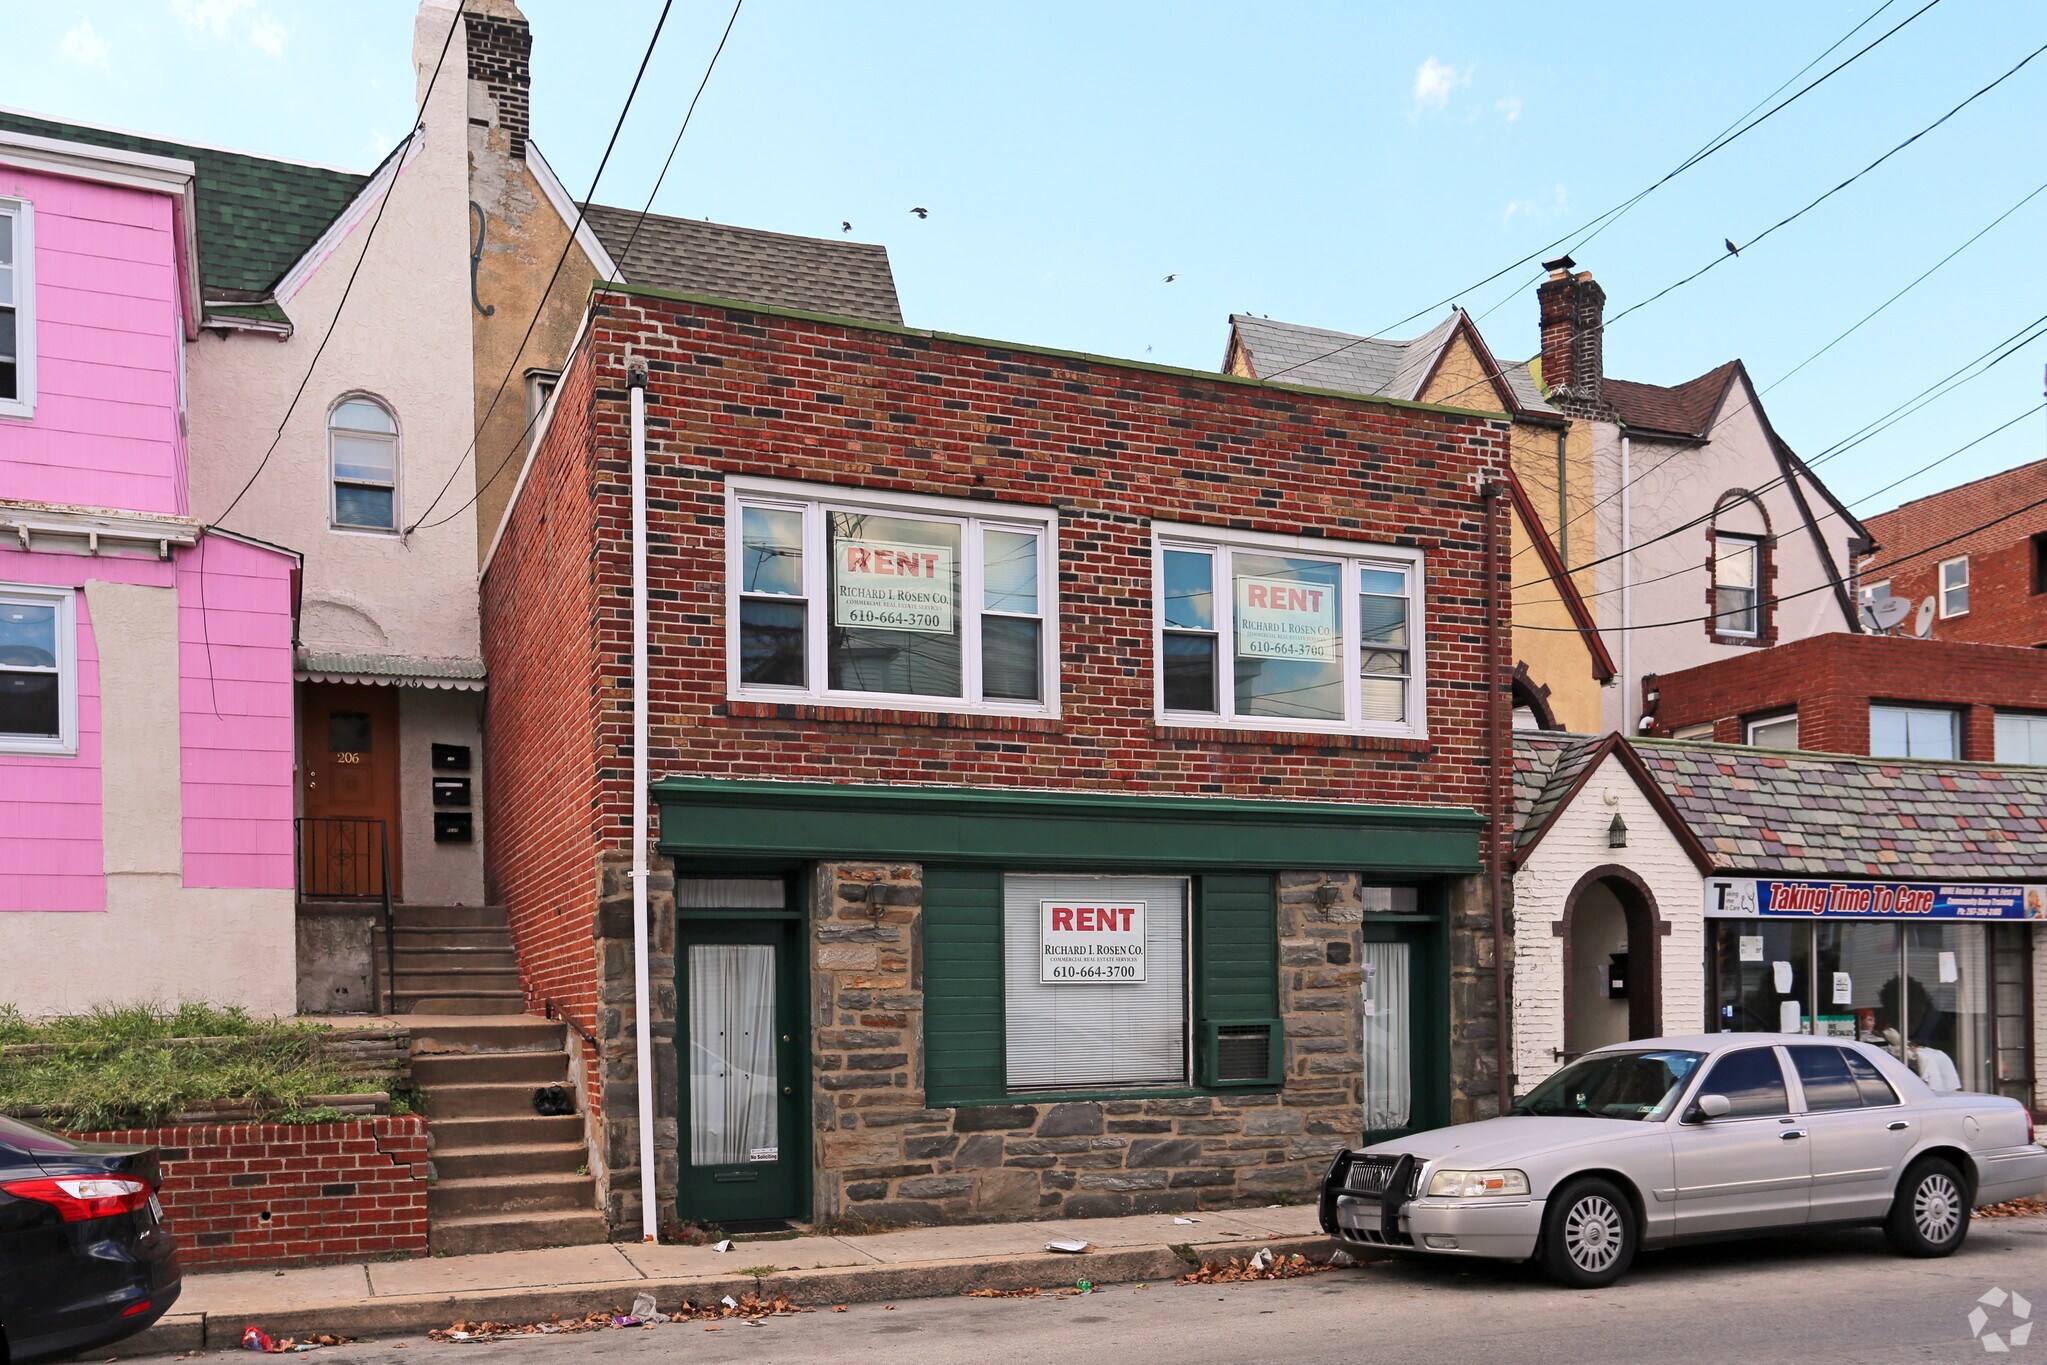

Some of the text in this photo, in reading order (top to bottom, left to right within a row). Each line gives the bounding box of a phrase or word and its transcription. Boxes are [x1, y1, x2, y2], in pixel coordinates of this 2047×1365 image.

[848, 547, 939, 578] RENT
[840, 586, 886, 600] RICHARD
[898, 590, 930, 602] ROSEN
[933, 593, 949, 604] CO.
[1248, 584, 1323, 612] RENT
[850, 610, 940, 627] 610-664-3700
[1242, 619, 1279, 632] RICHARD
[1289, 623, 1316, 634] ROSEN
[1318, 625, 1331, 636] CO.
[1250, 641, 1324, 656] 610-664-3700
[338, 752, 360, 764] 206
[1769, 882, 1935, 915] Taking Time To Care
[1052, 908, 1134, 931] RENT
[1045, 945, 1086, 955] RICHARD
[1097, 945, 1126, 955] ROSEN
[1128, 945, 1143, 955] CO.
[1054, 966, 1135, 977] 610-664-3700
